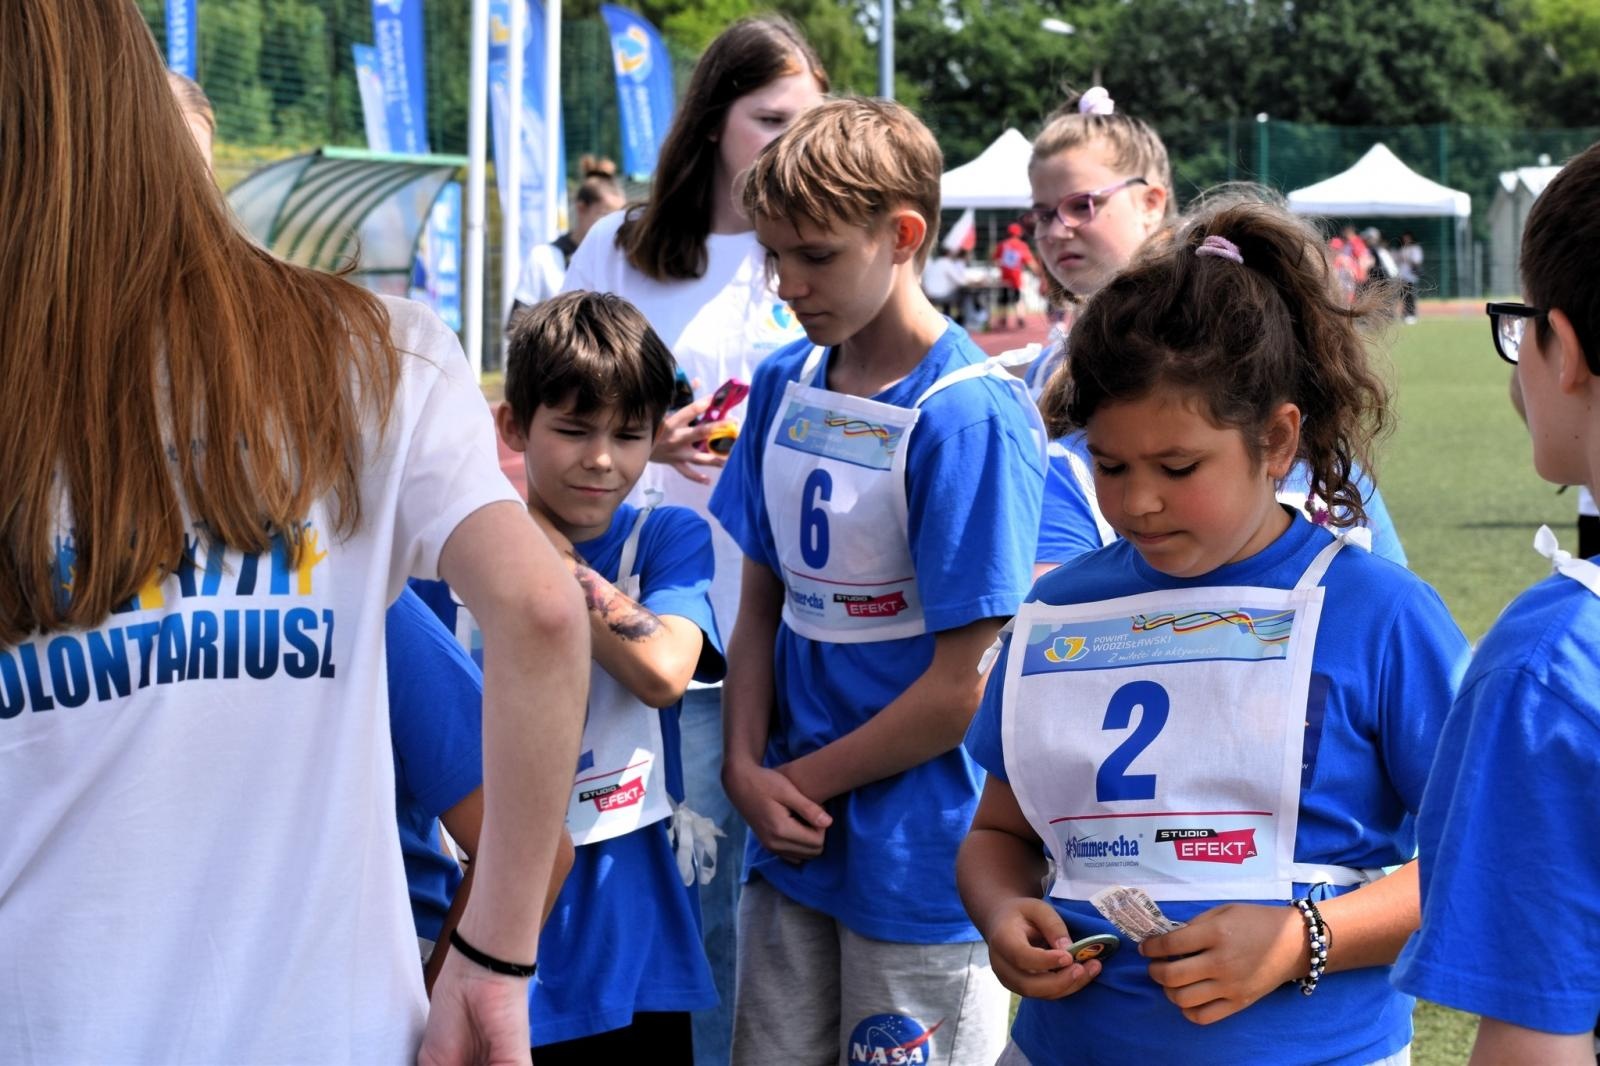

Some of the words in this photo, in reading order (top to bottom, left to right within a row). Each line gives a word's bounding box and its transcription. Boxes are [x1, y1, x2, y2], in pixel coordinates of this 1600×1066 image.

[800, 468, 833, 570] 6
[850, 601, 897, 615] EFEKT
[1092, 635, 1172, 652] WODZISŁAWSKI
[1093, 633, 1129, 643] POWIAT
[1096, 680, 1170, 803] 2
[582, 786, 617, 800] STUDIO
[600, 787, 639, 808] EFEKT
[1160, 830, 1209, 838] STUDIO
[1072, 835, 1139, 858] Summer-cha
[1181, 841, 1246, 857] EFEKT
[852, 1042, 924, 1065] NASA
